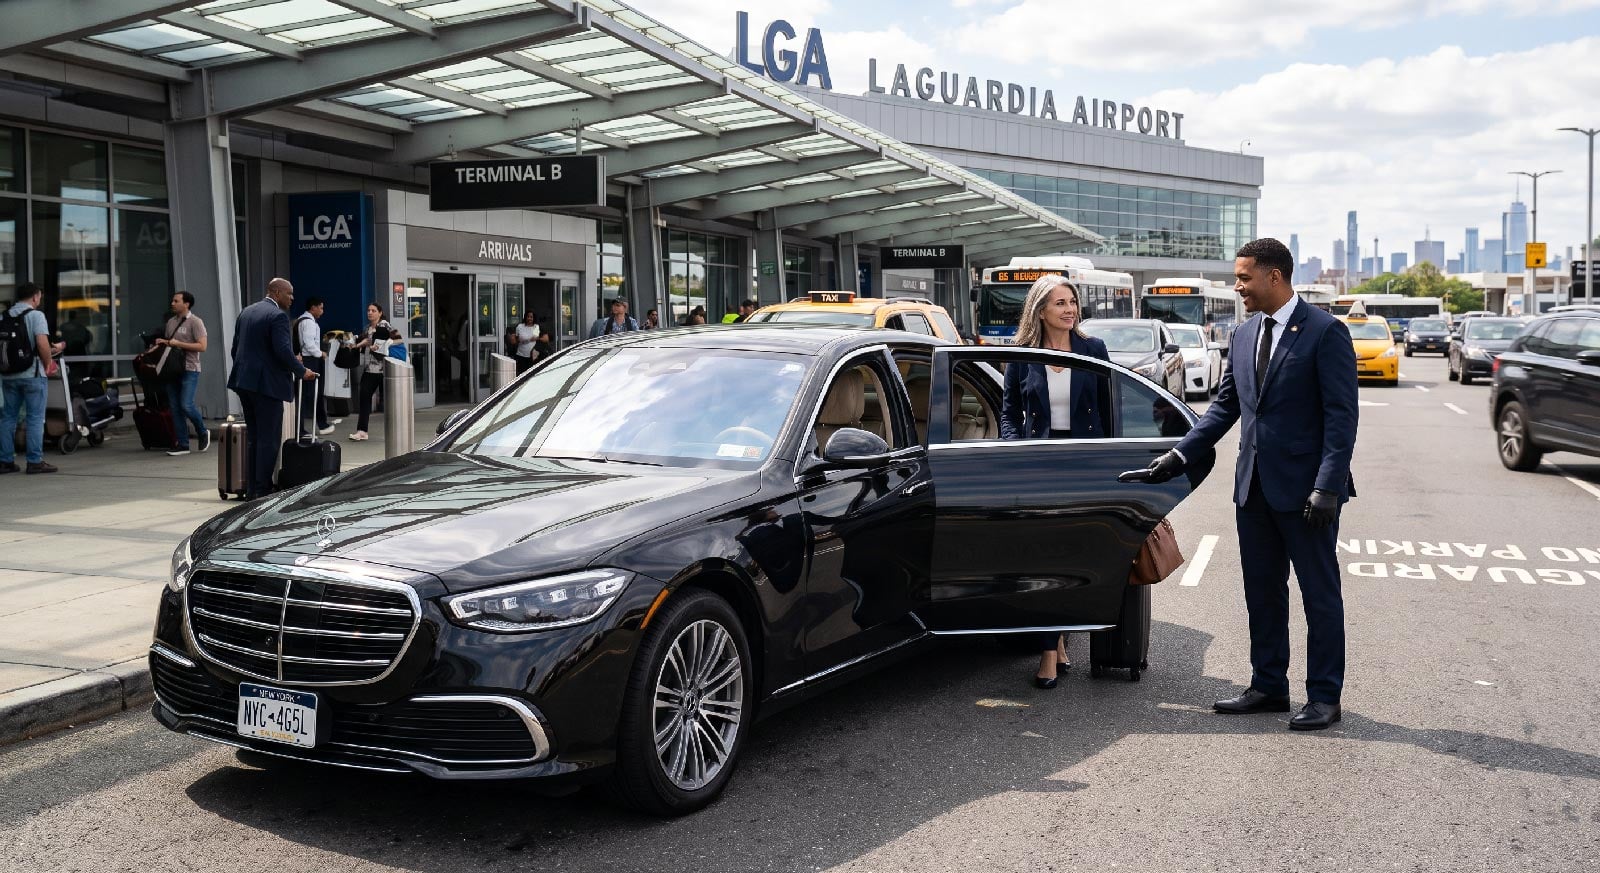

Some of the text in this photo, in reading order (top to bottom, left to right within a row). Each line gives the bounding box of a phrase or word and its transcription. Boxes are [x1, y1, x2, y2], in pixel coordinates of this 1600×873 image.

[736, 10, 833, 90] LGA
[868, 58, 1184, 140] LAGUARDIA AIRPORT
[455, 164, 562, 184] TERMINAL B
[298, 214, 352, 241] LGA
[478, 241, 532, 262] ARRIVALS
[893, 248, 946, 257] TERMINAL B
[821, 294, 839, 302] TAXI
[1335, 539, 1527, 561] PARKIN
[259, 689, 295, 702] NEW YORK
[243, 700, 266, 727] NYC
